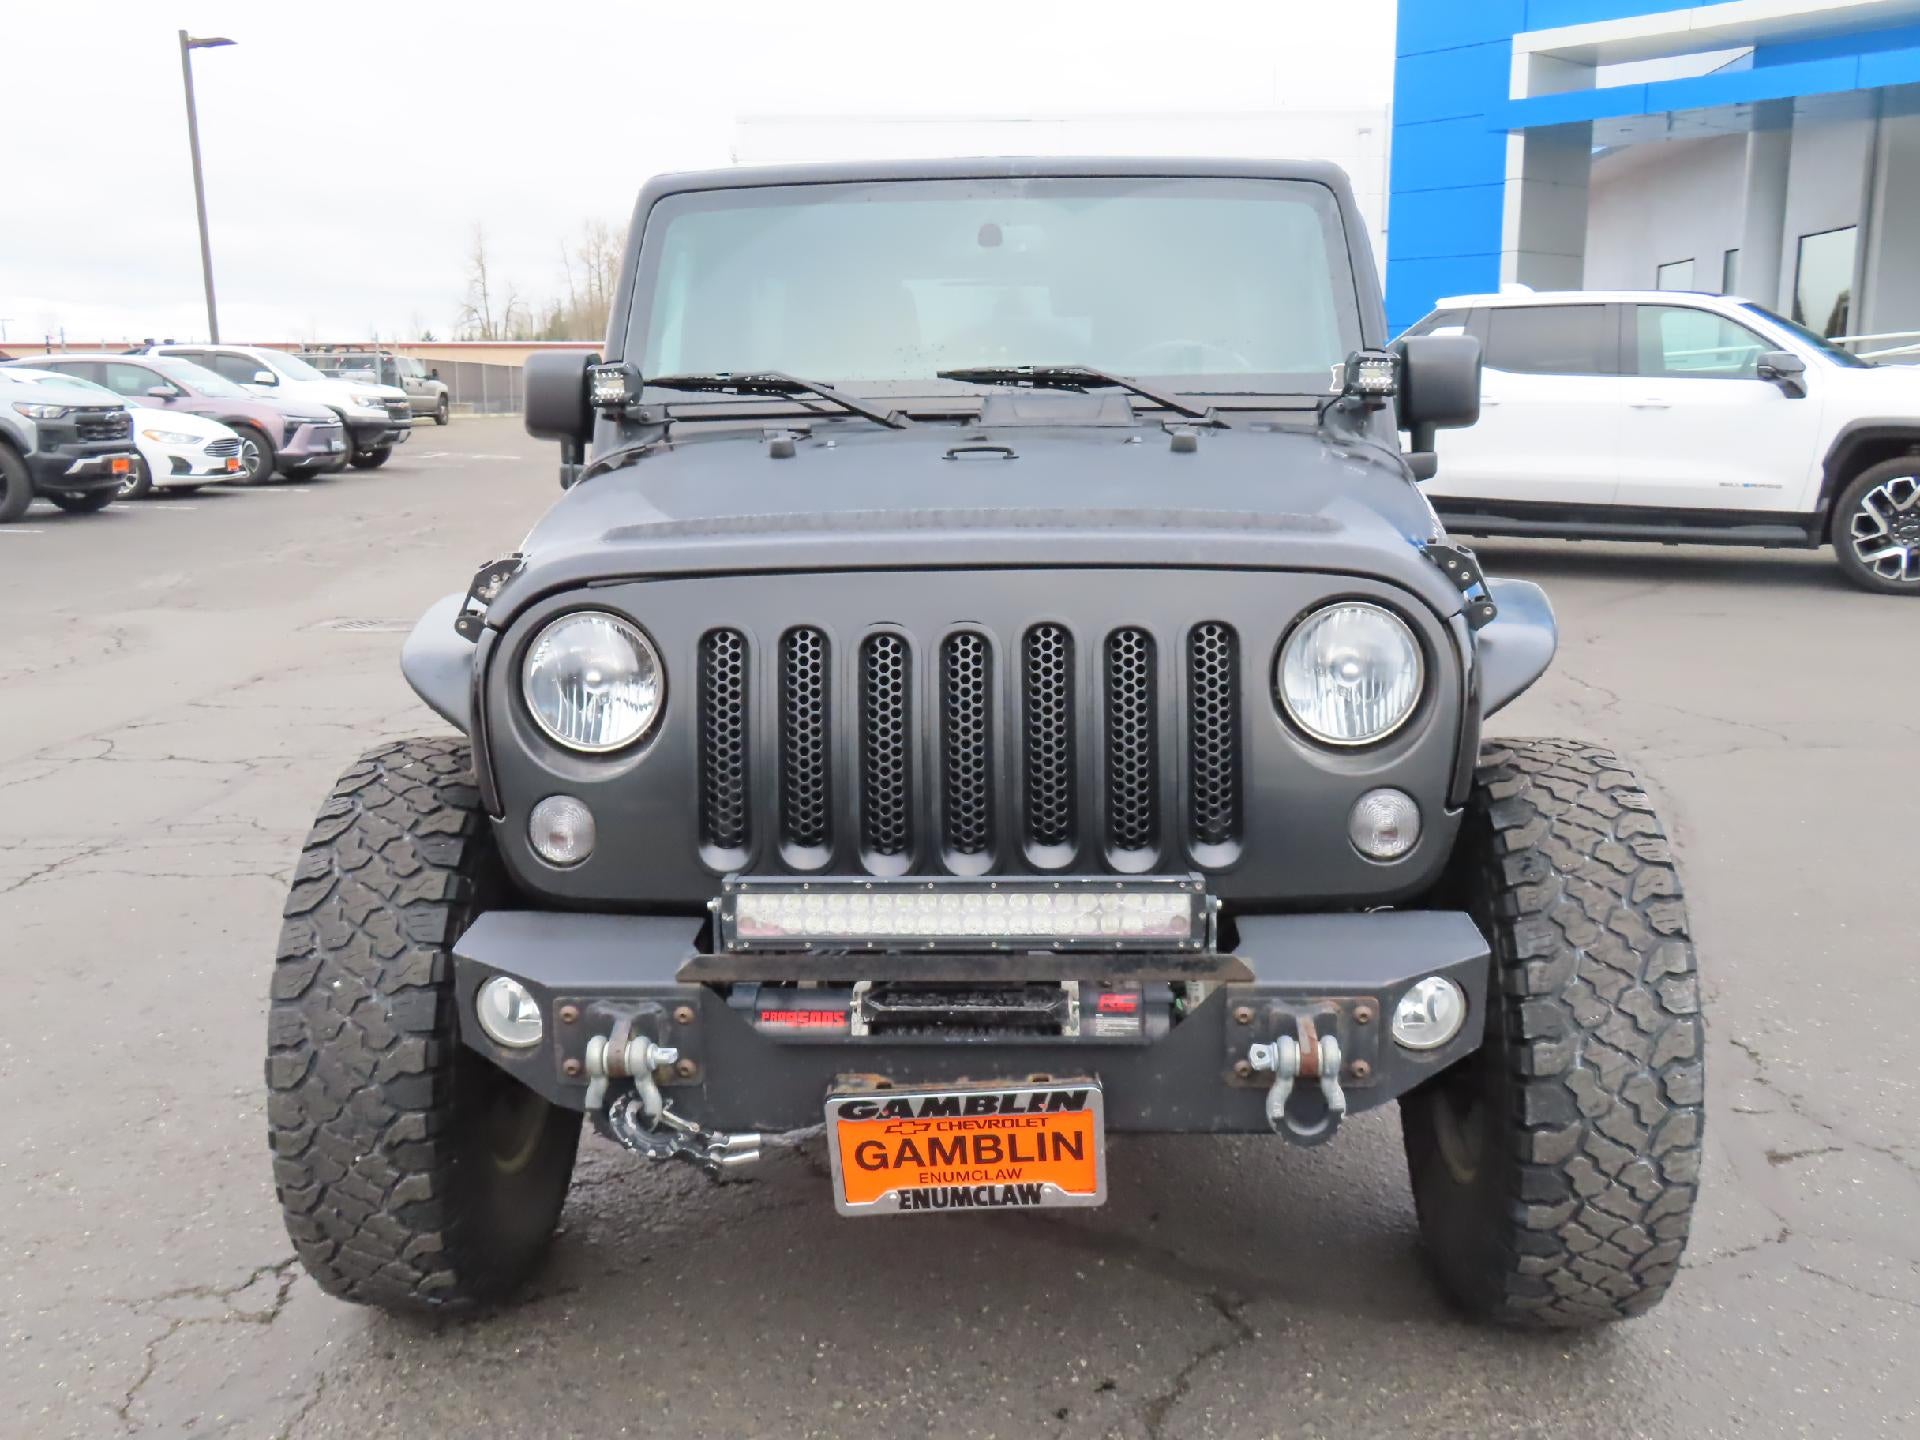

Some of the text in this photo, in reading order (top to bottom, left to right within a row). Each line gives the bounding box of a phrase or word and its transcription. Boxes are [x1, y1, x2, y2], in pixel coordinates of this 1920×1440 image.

[838, 1090, 1088, 1120] GAMBLIN
[936, 1117, 1049, 1131] CHEVROLET
[855, 1130, 1084, 1170] GAMBLIN
[920, 1168, 1022, 1183] ENUMCLAW
[899, 1183, 1043, 1209] ENUMCLAW
